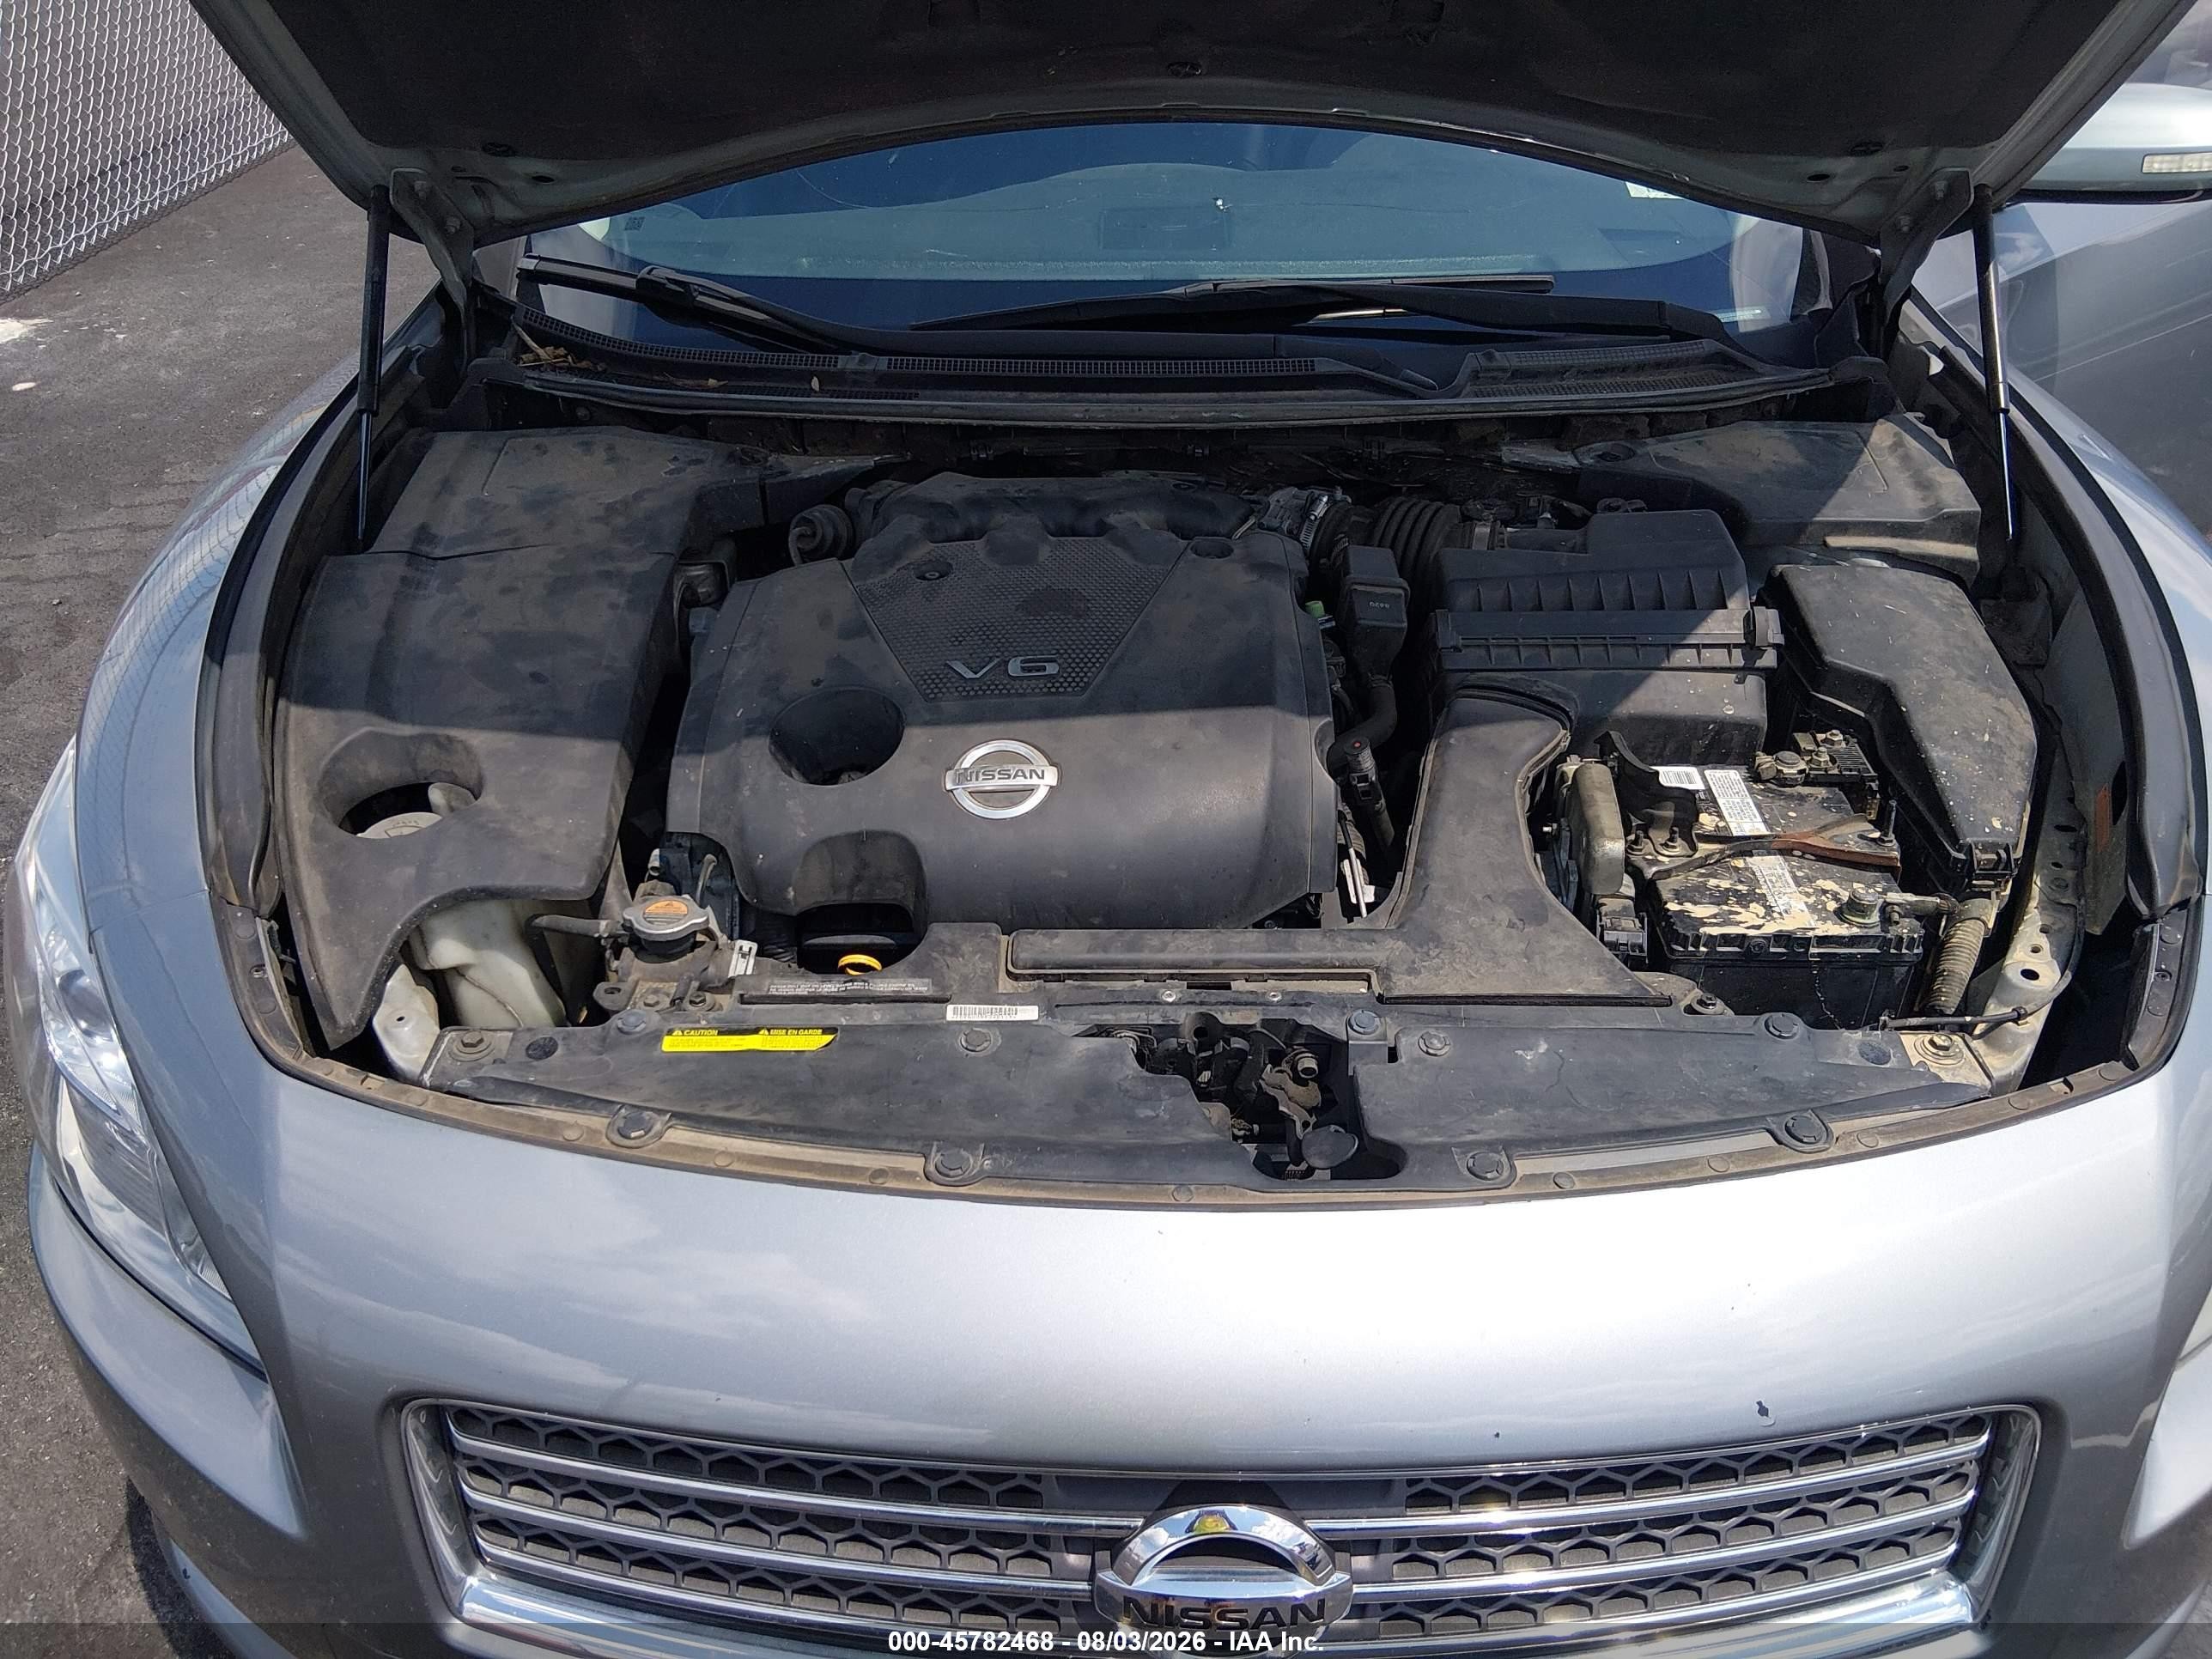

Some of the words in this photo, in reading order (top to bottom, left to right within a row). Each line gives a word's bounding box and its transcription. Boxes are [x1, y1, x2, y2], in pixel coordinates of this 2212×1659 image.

[946, 655, 1060, 678] V6
[954, 769, 1045, 785] NISSAN
[1122, 1595, 1326, 1631] NISSAN
